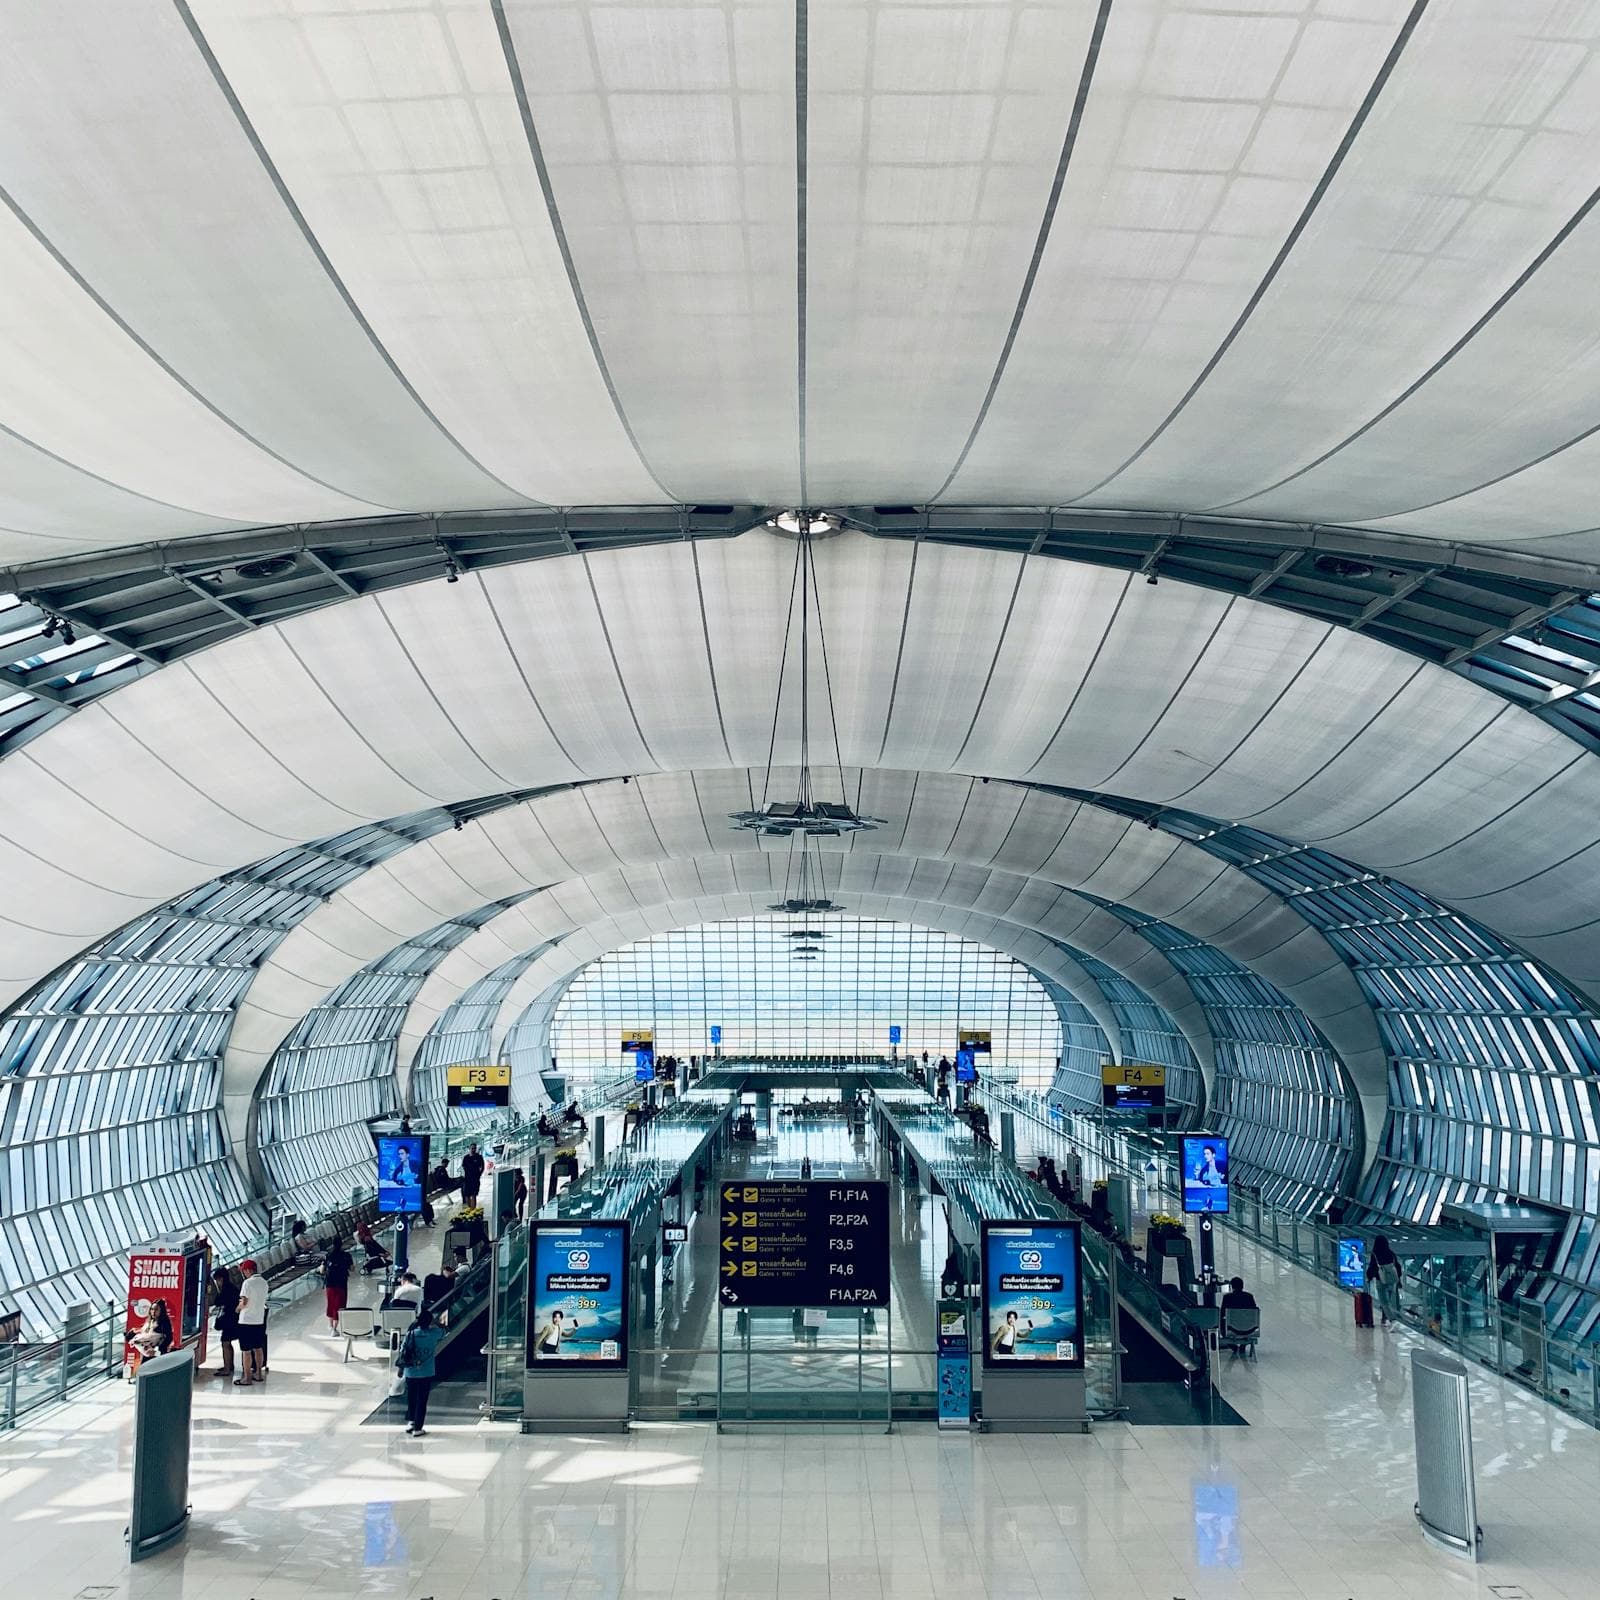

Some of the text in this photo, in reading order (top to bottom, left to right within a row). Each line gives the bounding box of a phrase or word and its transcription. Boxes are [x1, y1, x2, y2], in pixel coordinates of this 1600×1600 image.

[469, 1069, 487, 1083] F3
[1124, 1069, 1143, 1083] F4
[829, 1190, 869, 1202] F1,F1A
[829, 1214, 869, 1227] F2,F2A
[829, 1239, 854, 1251] F3,5
[134, 1259, 180, 1275] SNACK
[829, 1264, 854, 1276] F4,6
[829, 1289, 877, 1302] F1A,F2A
